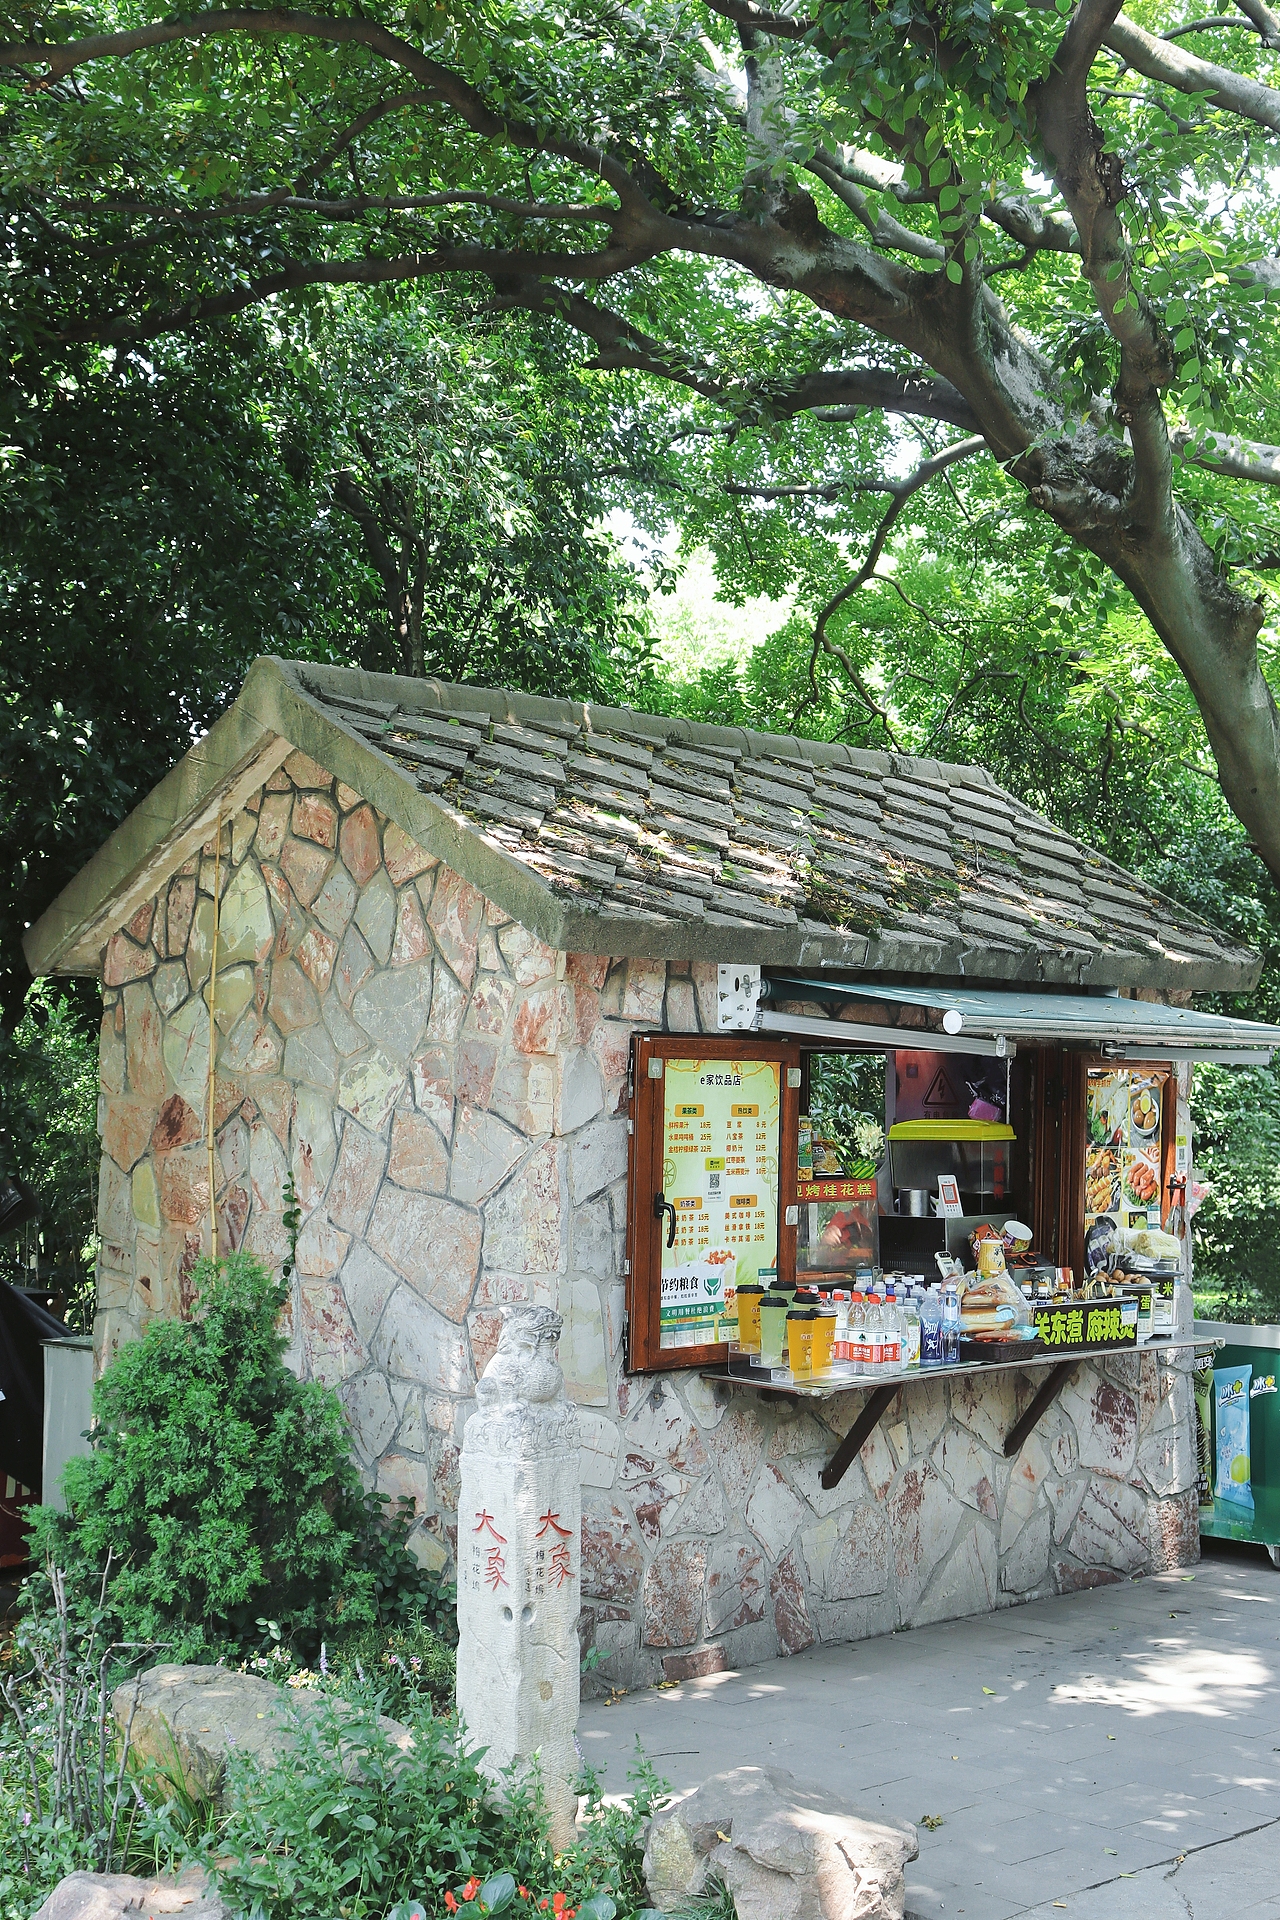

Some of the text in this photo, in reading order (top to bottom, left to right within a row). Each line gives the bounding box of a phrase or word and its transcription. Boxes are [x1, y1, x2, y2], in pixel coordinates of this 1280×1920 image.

[700, 1074, 741, 1086] e家饮品店
[667, 1238, 694, 1246] 果奶茶
[662, 1276, 699, 1292] 节约粮食
[1035, 1309, 1083, 1345] 关东煮
[472, 1509, 510, 1591] 大象
[536, 1509, 575, 1588] 大象
